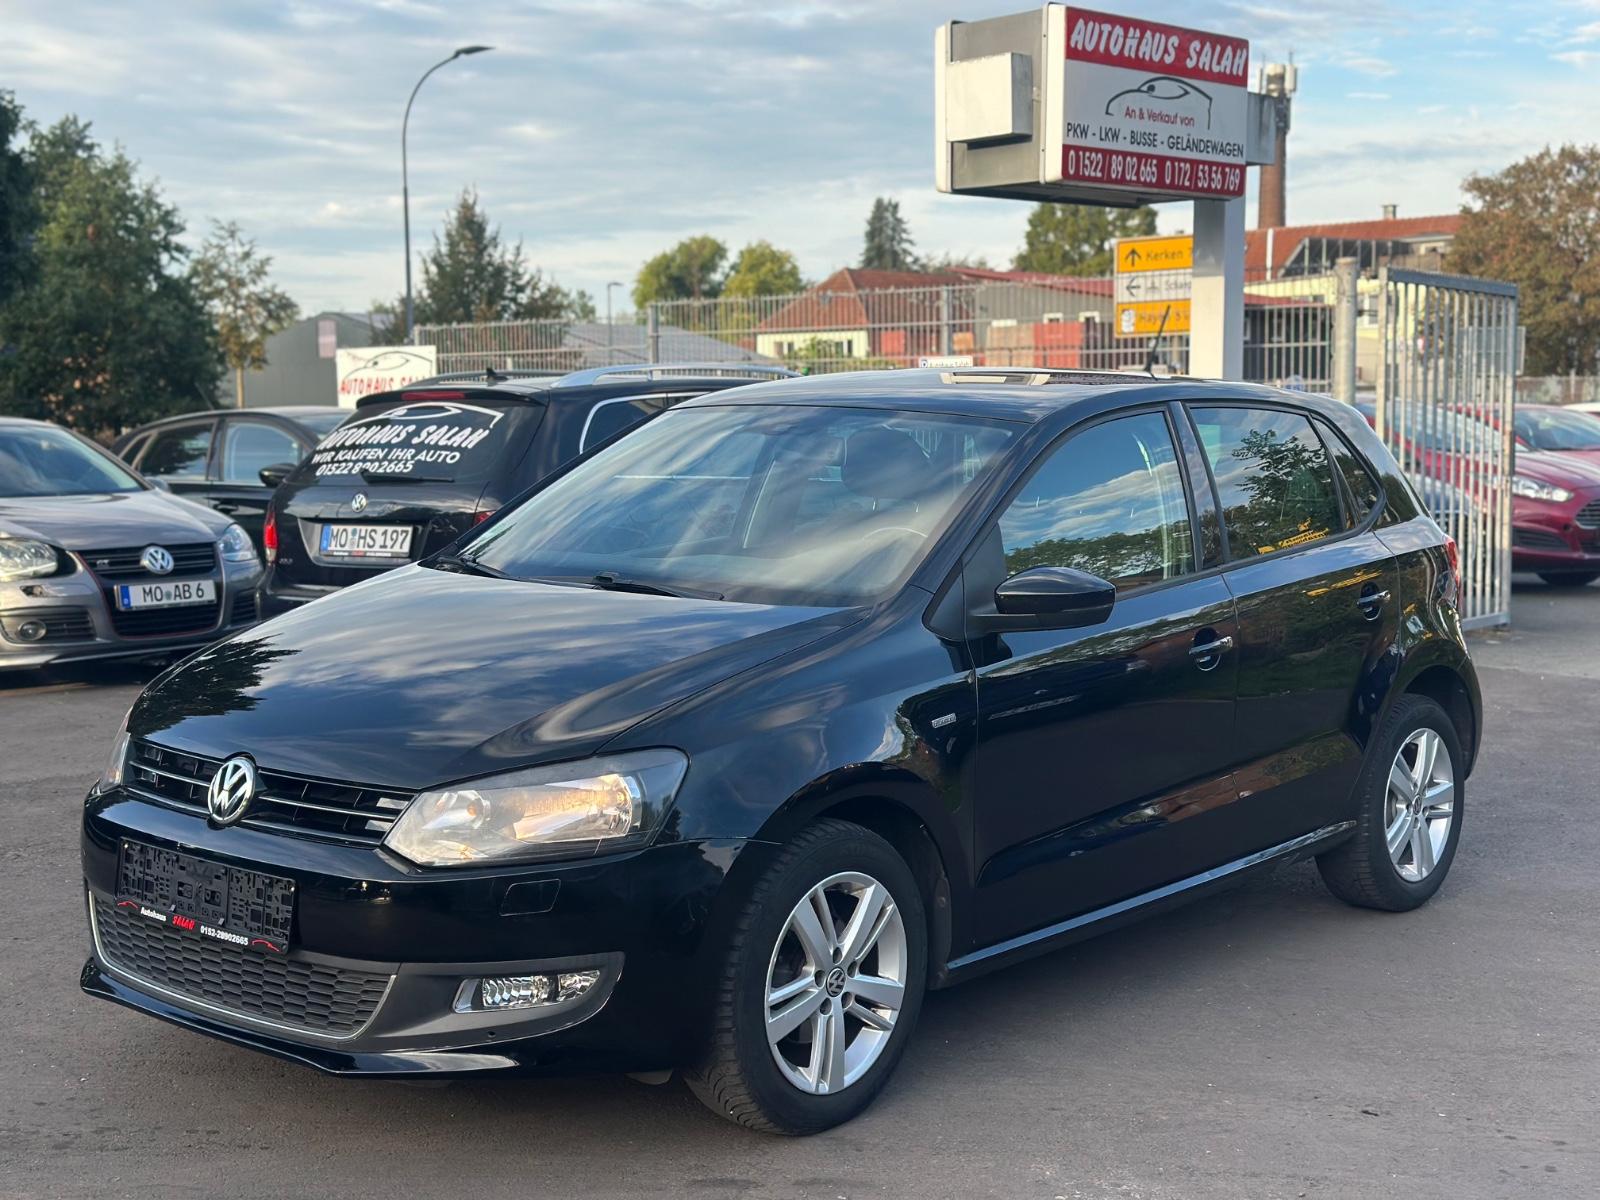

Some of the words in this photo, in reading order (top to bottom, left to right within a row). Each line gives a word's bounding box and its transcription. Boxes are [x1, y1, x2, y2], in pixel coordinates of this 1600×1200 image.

[1070, 18, 1179, 65] AUTOHAUS
[1186, 39, 1247, 77] SALAH
[1125, 106, 1137, 119] An
[1138, 107, 1145, 120] &
[1147, 108, 1178, 126] Verkauf
[1179, 116, 1195, 127] von
[1066, 122, 1090, 139] PKW
[1099, 126, 1121, 143] LKW
[1130, 130, 1158, 148] BUSSE
[1167, 133, 1244, 158] GELÄNDEWAGEN
[1068, 150, 1076, 175] 0
[1079, 151, 1103, 177] 1522
[1111, 154, 1124, 180] 89
[1125, 156, 1138, 181] 02
[1139, 158, 1157, 183] 665
[1164, 160, 1171, 185] 0
[1174, 162, 1190, 187] 172
[1197, 164, 1210, 190] 53
[1210, 166, 1222, 190] 56
[1224, 167, 1241, 192] 769
[316, 425, 416, 450] AUTOHAUS
[412, 425, 490, 449] SALAH
[311, 451, 336, 464] WIR
[334, 448, 388, 462] KAUFEN
[387, 448, 416, 461] IHR
[414, 449, 461, 464] AUTO
[330, 528, 348, 548] MO
[380, 529, 410, 549] 197
[142, 586, 164, 603] MO
[173, 584, 192, 600] AB
[196, 582, 204, 598] 6
[140, 906, 167, 922] Autohaus
[172, 914, 195, 930] SALAH
